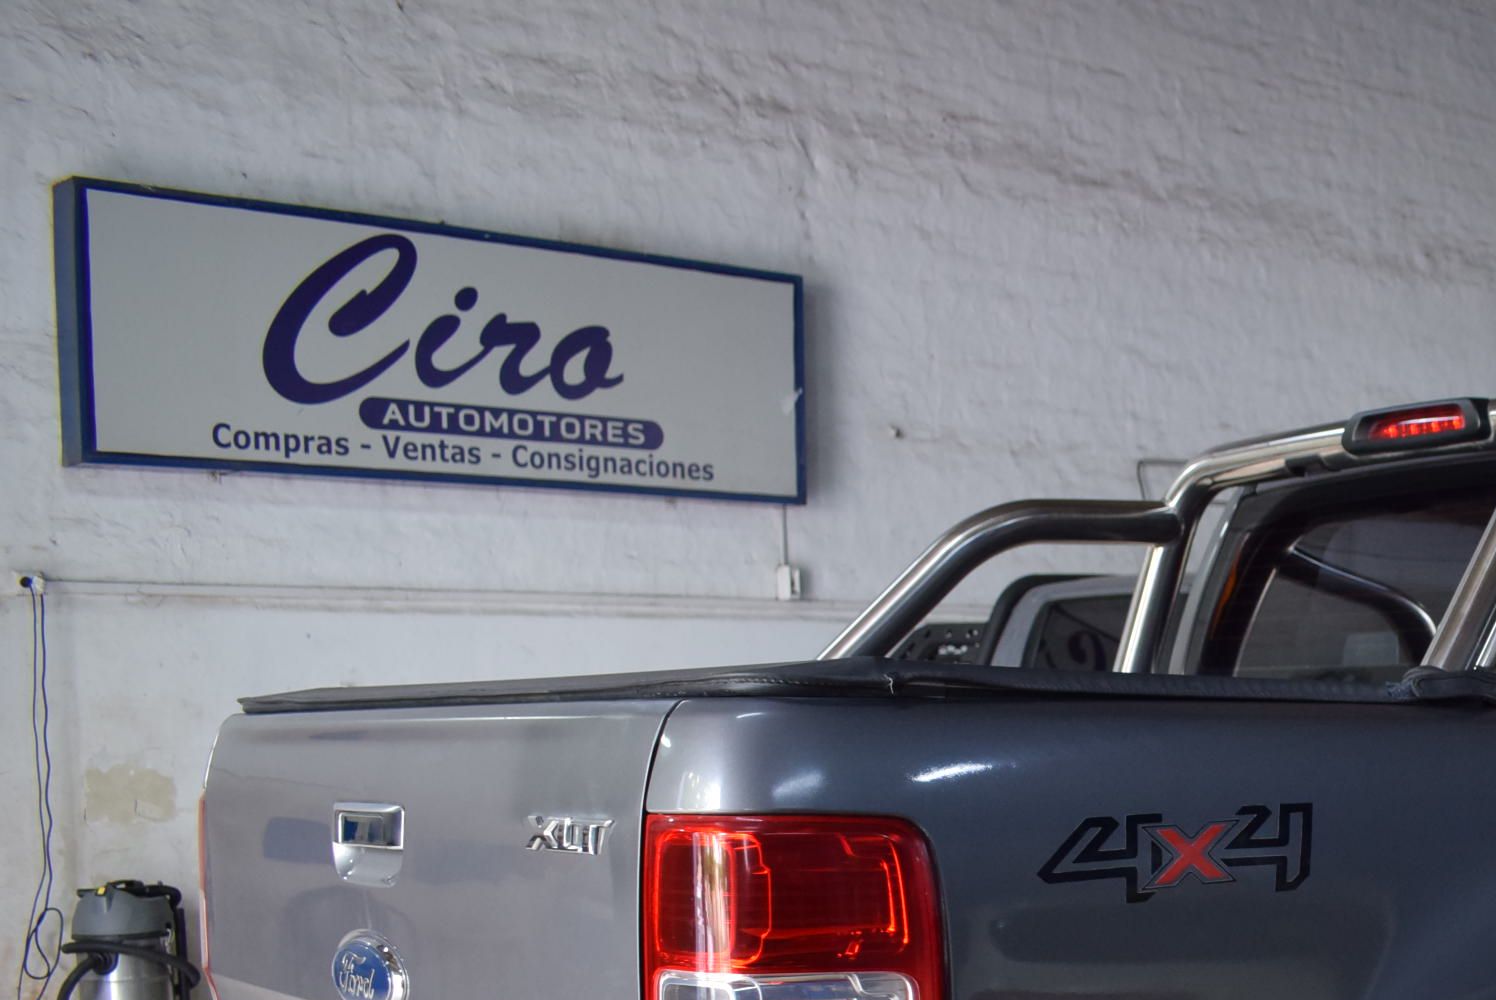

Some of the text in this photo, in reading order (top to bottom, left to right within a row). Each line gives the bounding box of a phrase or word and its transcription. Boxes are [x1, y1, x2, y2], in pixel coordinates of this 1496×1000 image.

[263, 234, 624, 404] Ciro
[382, 402, 646, 446] AUTOMOTORES
[212, 423, 350, 458] Compras
[381, 434, 481, 465] Ventas
[511, 445, 714, 481] Consignaciones
[525, 815, 615, 855] XLT
[340, 951, 375, 999] Ford
